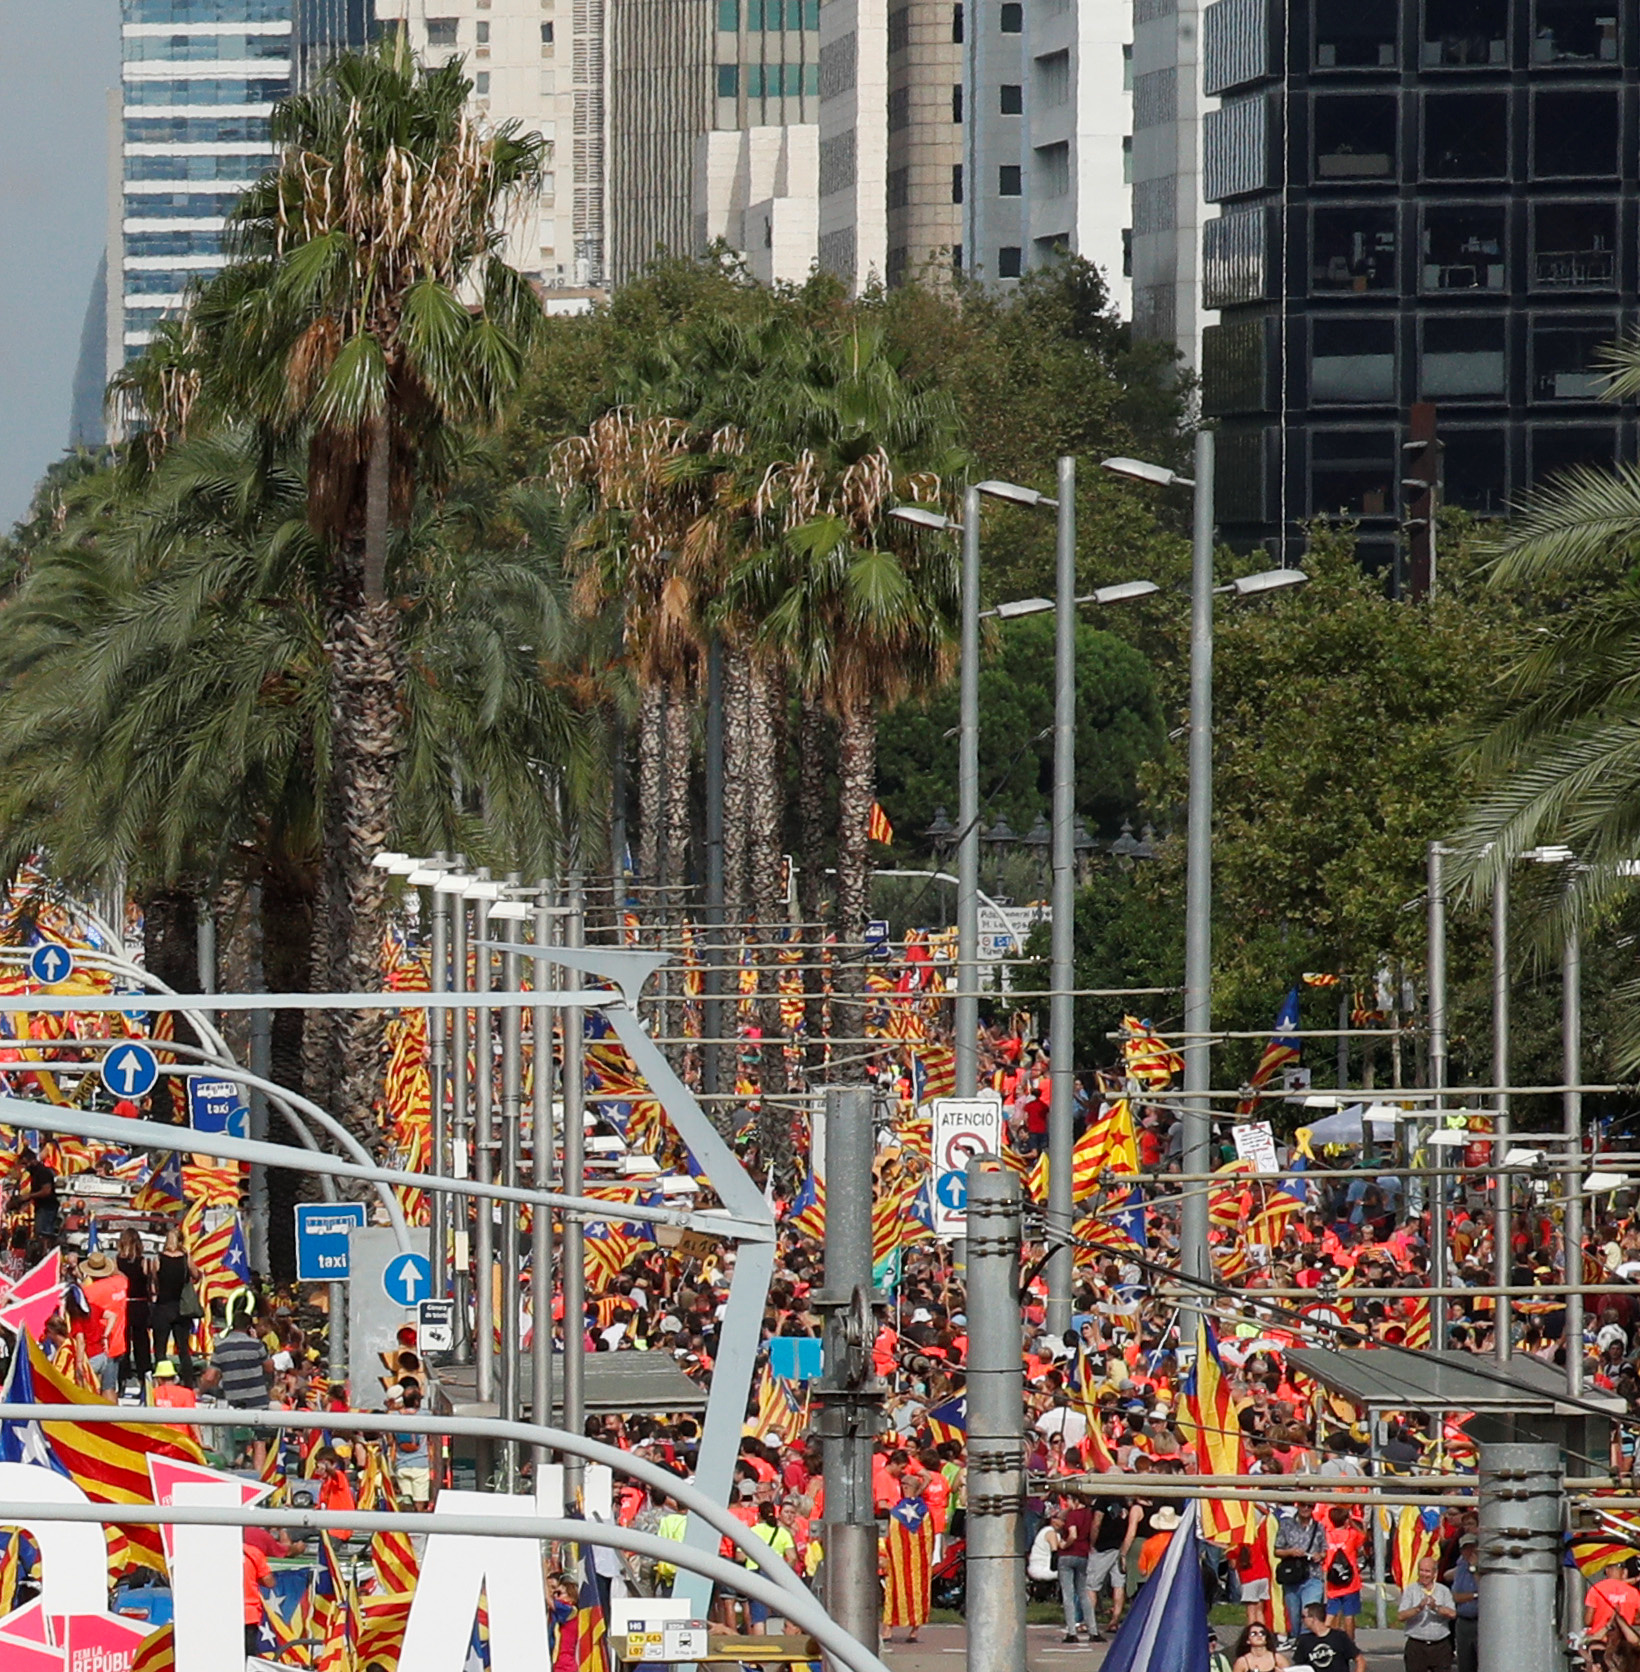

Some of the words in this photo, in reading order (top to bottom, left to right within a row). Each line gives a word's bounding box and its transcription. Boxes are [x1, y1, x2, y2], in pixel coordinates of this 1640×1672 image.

[207, 1101, 229, 1114] taxi
[942, 1109, 994, 1126] ATENCIÓ
[318, 1253, 347, 1268] taxi
[72, 1647, 91, 1662] FEM
[91, 1645, 104, 1658] LA
